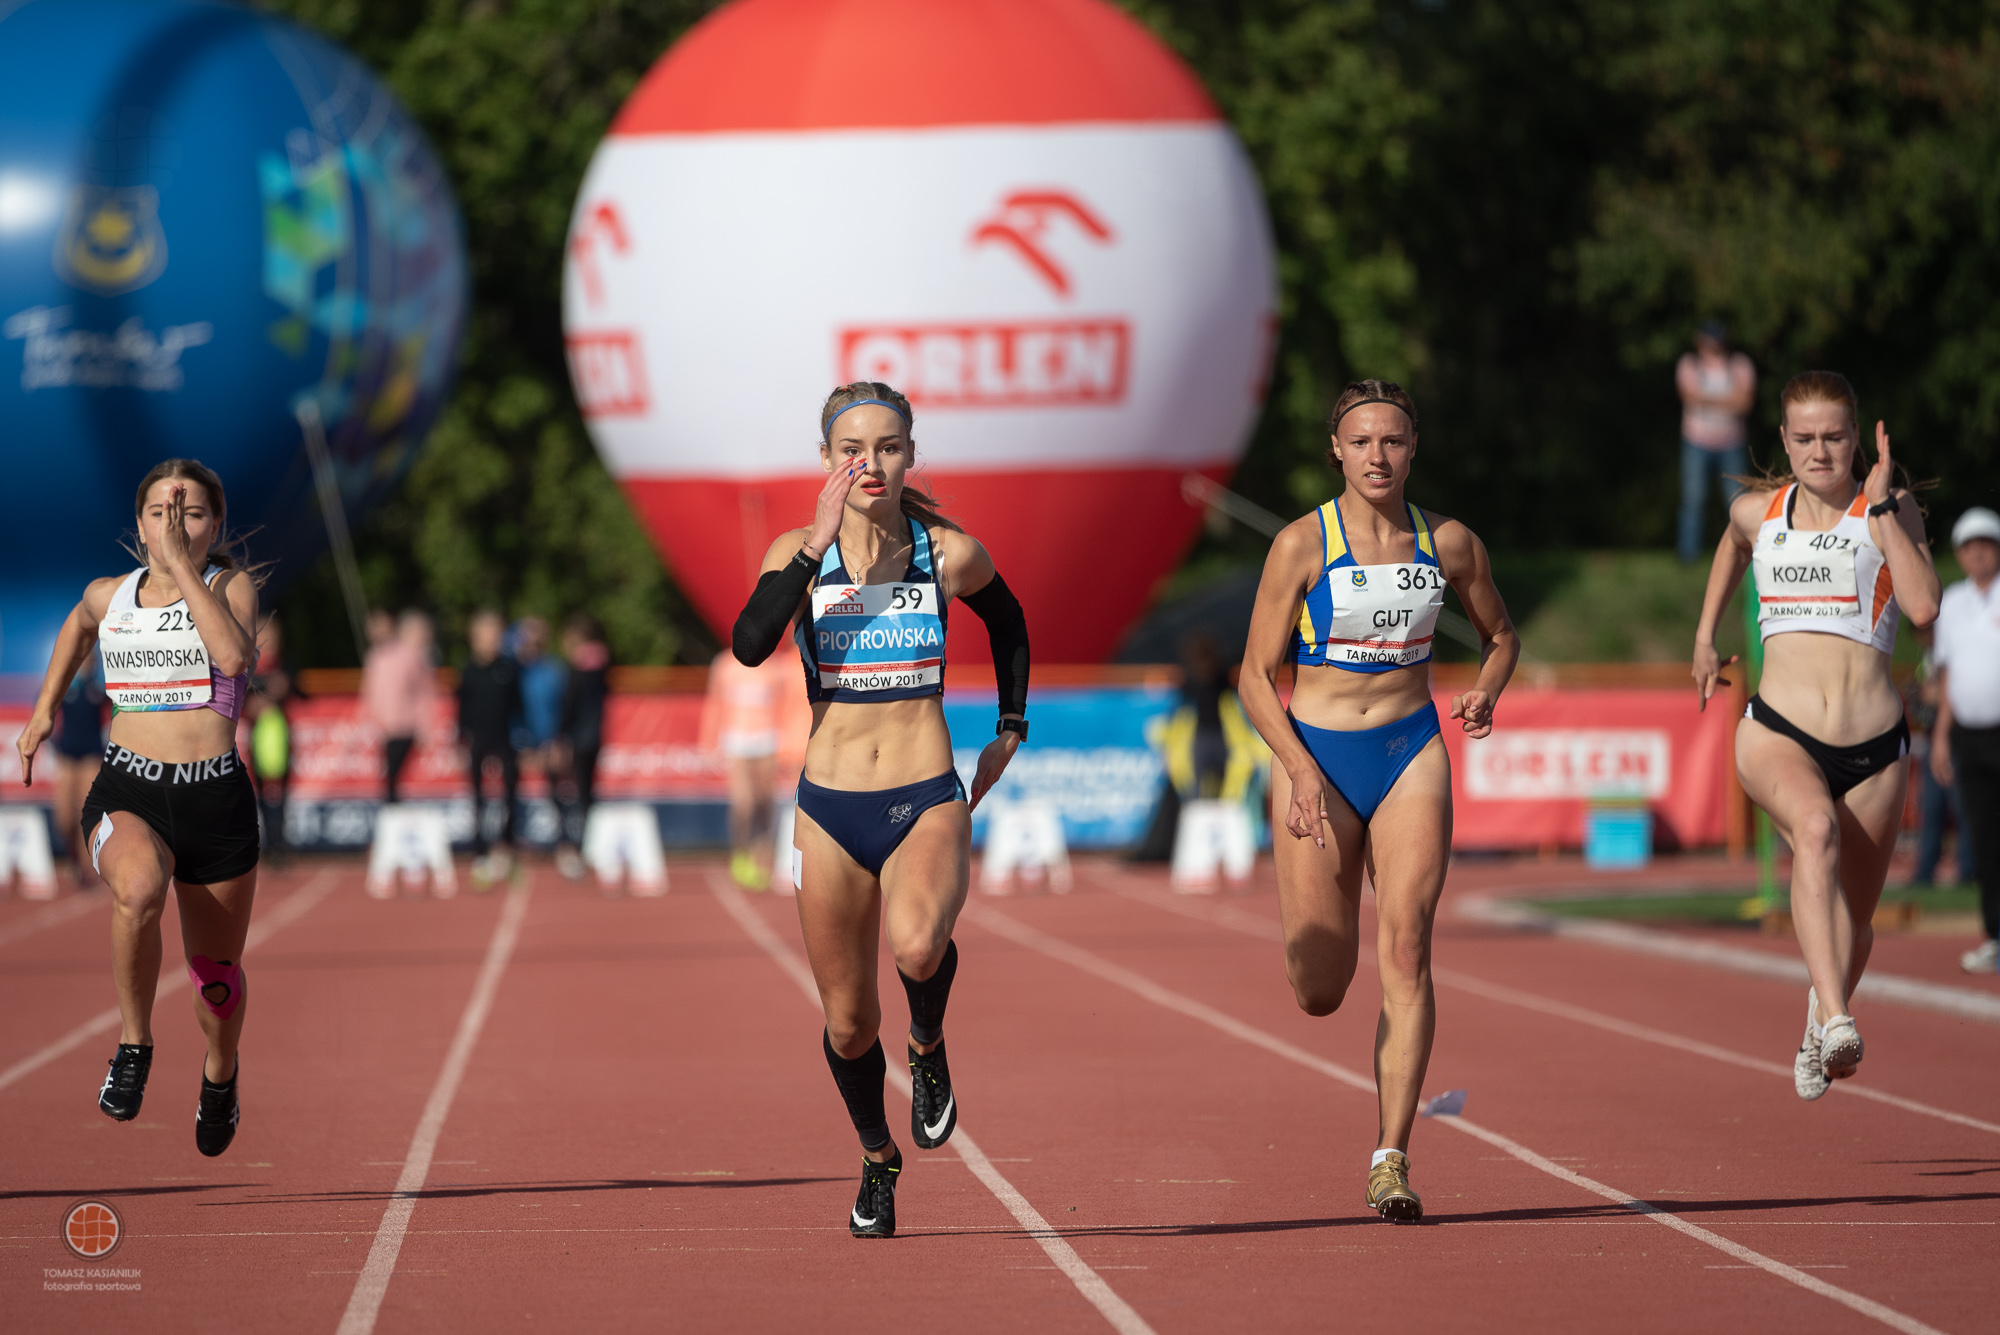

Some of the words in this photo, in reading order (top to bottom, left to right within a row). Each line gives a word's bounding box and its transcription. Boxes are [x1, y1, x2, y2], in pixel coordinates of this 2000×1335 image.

[850, 330, 1114, 396] ORLEN
[1397, 567, 1441, 590] 361
[1773, 566, 1832, 583] KOZAR
[892, 587, 923, 609] 59
[826, 604, 862, 613] ORLEN
[1769, 605, 1812, 616] TARNÓW
[1816, 607, 1841, 616] 2019
[1373, 610, 1413, 627] GUT
[820, 627, 939, 650] PIOTROWSKA
[105, 649, 206, 669] KWASIBORSKA
[1346, 649, 1398, 662] TARNÓW
[1401, 649, 1419, 662] 2019
[836, 674, 892, 688] TARNÓW
[896, 674, 923, 686] 2019
[119, 691, 162, 703] TARNÓW
[165, 691, 193, 703] 2019
[111, 747, 164, 781] PRO
[173, 751, 234, 784] NIKE
